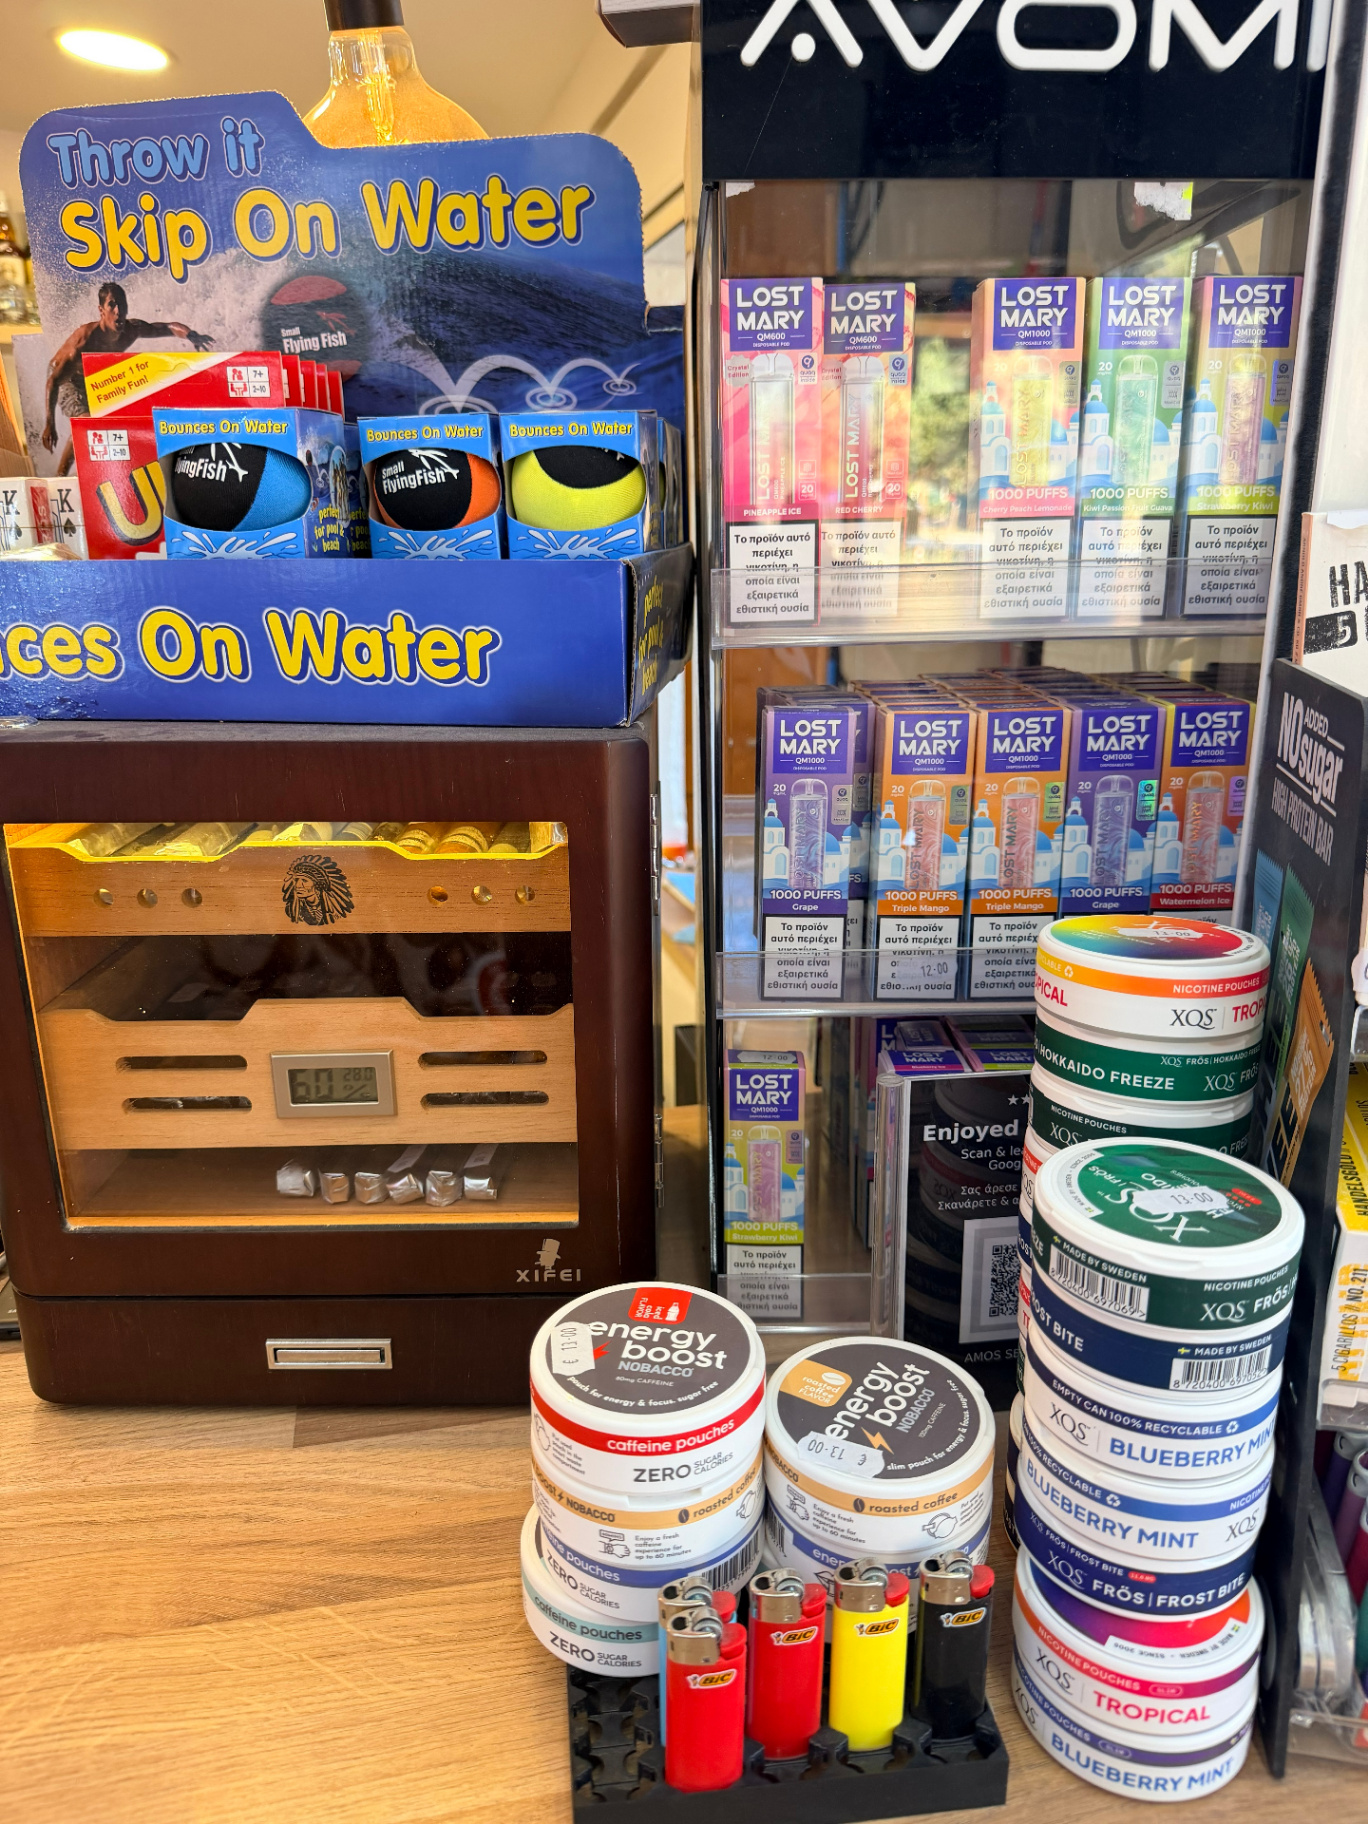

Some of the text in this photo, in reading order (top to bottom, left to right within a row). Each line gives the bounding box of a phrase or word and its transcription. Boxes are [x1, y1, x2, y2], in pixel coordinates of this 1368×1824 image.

[47, 116, 265, 188] Throw it
[59, 175, 596, 283] Skip On Water
[737, 286, 804, 308] LOST
[830, 290, 898, 312] LOST
[1001, 286, 1069, 306] LOST
[1108, 286, 1177, 306] LOST
[737, 310, 804, 331] MARY
[830, 314, 897, 335] MARY
[1000, 307, 1068, 328] MARY
[1107, 307, 1175, 328] MARY
[281, 327, 300, 337] Small
[756, 332, 786, 342] QM600
[282, 331, 347, 354] Flying Fish
[90, 360, 149, 392] Number 1 for
[252, 369, 264, 379] 7+
[96, 375, 149, 404] Family Fun!
[252, 384, 267, 394] 2-10
[159, 420, 288, 435] Bounces On Water
[366, 425, 483, 442] Bounces On Water
[509, 422, 633, 438] Bounces On Water
[382, 460, 405, 479] Small
[382, 468, 446, 495] FlyingFish
[988, 488, 1068, 501] 1000 PUFFS
[743, 506, 802, 517] PINEAPPLE ICE
[835, 505, 884, 514] RED CHERRY
[983, 505, 1008, 515] Cherry
[1010, 504, 1032, 513] Peach
[734, 532, 811, 546] Το προϊόν αυτό
[752, 547, 793, 560] περιέχει
[140, 607, 252, 683] On
[265, 607, 500, 685] Water
[780, 719, 842, 736] LOST
[900, 720, 962, 737] LOST
[994, 717, 1057, 735] LOST
[1088, 715, 1152, 734] LOST
[1277, 692, 1329, 769] NO ADDED
[780, 738, 841, 755] MARY
[899, 739, 962, 756] MARY
[993, 736, 1056, 754] MARY
[1087, 734, 1150, 752] MARY
[1299, 730, 1344, 805] sugar
[1287, 791, 1316, 850] PROTEIN
[1315, 817, 1334, 867] BAR
[770, 889, 841, 900] 1000 PUFFS
[885, 891, 957, 901] 1000 PUFFS
[1159, 896, 1229, 907] Watermelon Ice
[792, 903, 819, 912] Grape
[892, 903, 950, 914] Triple Mango
[1173, 977, 1260, 994] NICOTINE POUCHES
[1169, 1008, 1213, 1030] XQS
[1040, 1044, 1174, 1091] HOKKAIDO FREEZE
[736, 1074, 792, 1090] LOST
[736, 1091, 792, 1105] MARY
[750, 1106, 778, 1114] QM1000
[923, 1120, 1019, 1143] Enjoyed
[960, 1148, 1006, 1160] Scan &
[960, 1183, 1018, 1196] Σας άρεσε
[937, 1198, 1009, 1210] Σκανάρετε &
[731, 1221, 798, 1232] 1000 PUFFS
[732, 1232, 798, 1242] Strawberry Kiwi
[1062, 1242, 1147, 1283] MADE BY SWEDEN
[515, 1268, 581, 1283] XIFEI
[1200, 1286, 1288, 1322] XQS FRÖS
[590, 1321, 716, 1351] energy
[621, 1340, 727, 1370] boost
[617, 1360, 694, 1377] NOBACCO
[824, 1362, 899, 1441] energy
[865, 1363, 930, 1427] boost
[896, 1387, 935, 1433] NOBACCO
[1052, 1379, 1222, 1435] EMPTY CAN 100% RECYCLABLE
[606, 1435, 672, 1453] caffeine
[675, 1419, 735, 1448] pouches
[1050, 1402, 1245, 1468] XQS BLUEBERRY
[633, 1464, 692, 1483] ZERO
[868, 1491, 958, 1513] roasted coffee
[1026, 1457, 1132, 1540] BLUEBERRY
[1137, 1530, 1199, 1549] MINT
[1047, 1550, 1088, 1590] XQS
[1218, 1574, 1246, 1598] BITE
[1037, 1625, 1082, 1670] NICOTINE
[1082, 1661, 1141, 1692] POUCHES
[1036, 1646, 1073, 1695] XQS
[1092, 1690, 1211, 1724] TROPICAL
[1050, 1734, 1184, 1793] BLUEBERRY
[1186, 1756, 1234, 1790] MINT
